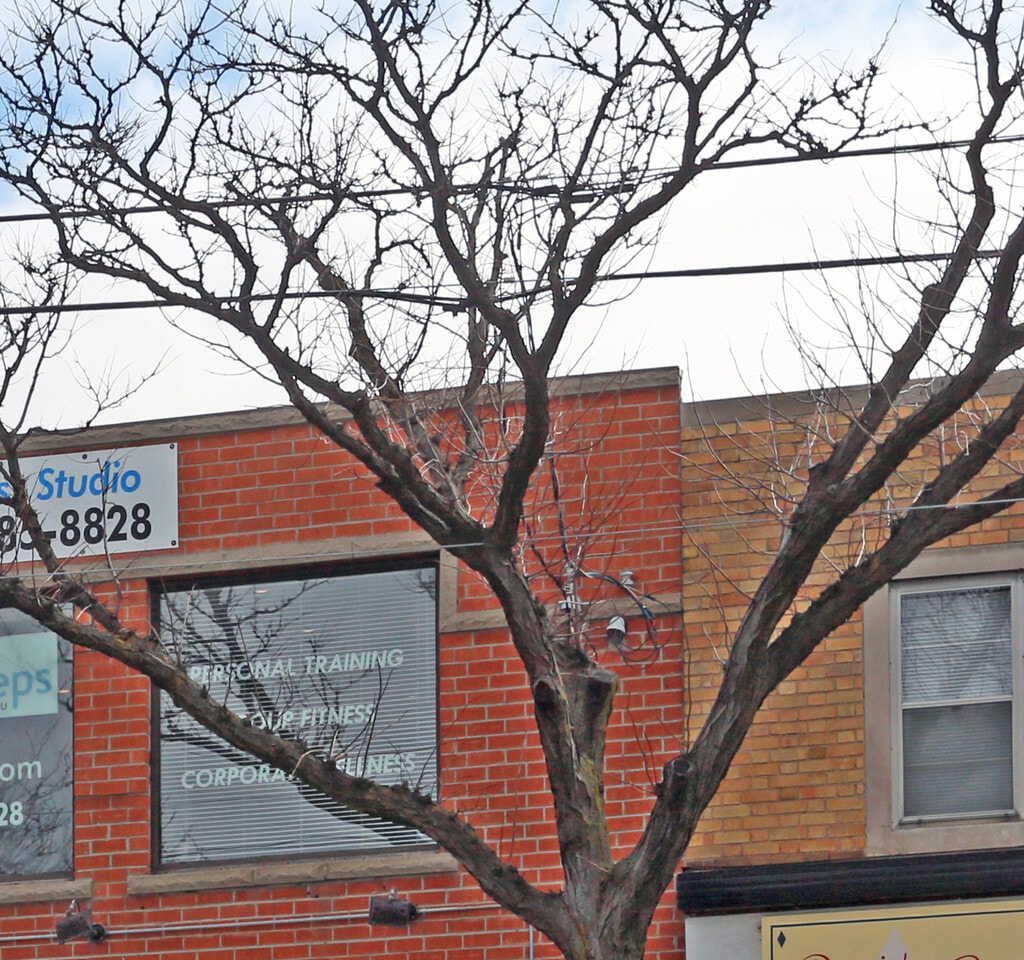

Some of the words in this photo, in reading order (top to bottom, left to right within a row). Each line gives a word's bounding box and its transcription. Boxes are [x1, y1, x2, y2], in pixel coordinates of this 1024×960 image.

[36, 459, 142, 501] Studio
[189, 656, 296, 684] PERSONAL
[304, 649, 405, 676] TRAINING
[300, 703, 375, 729] FITNESS
[181, 765, 287, 789] CORPORA
